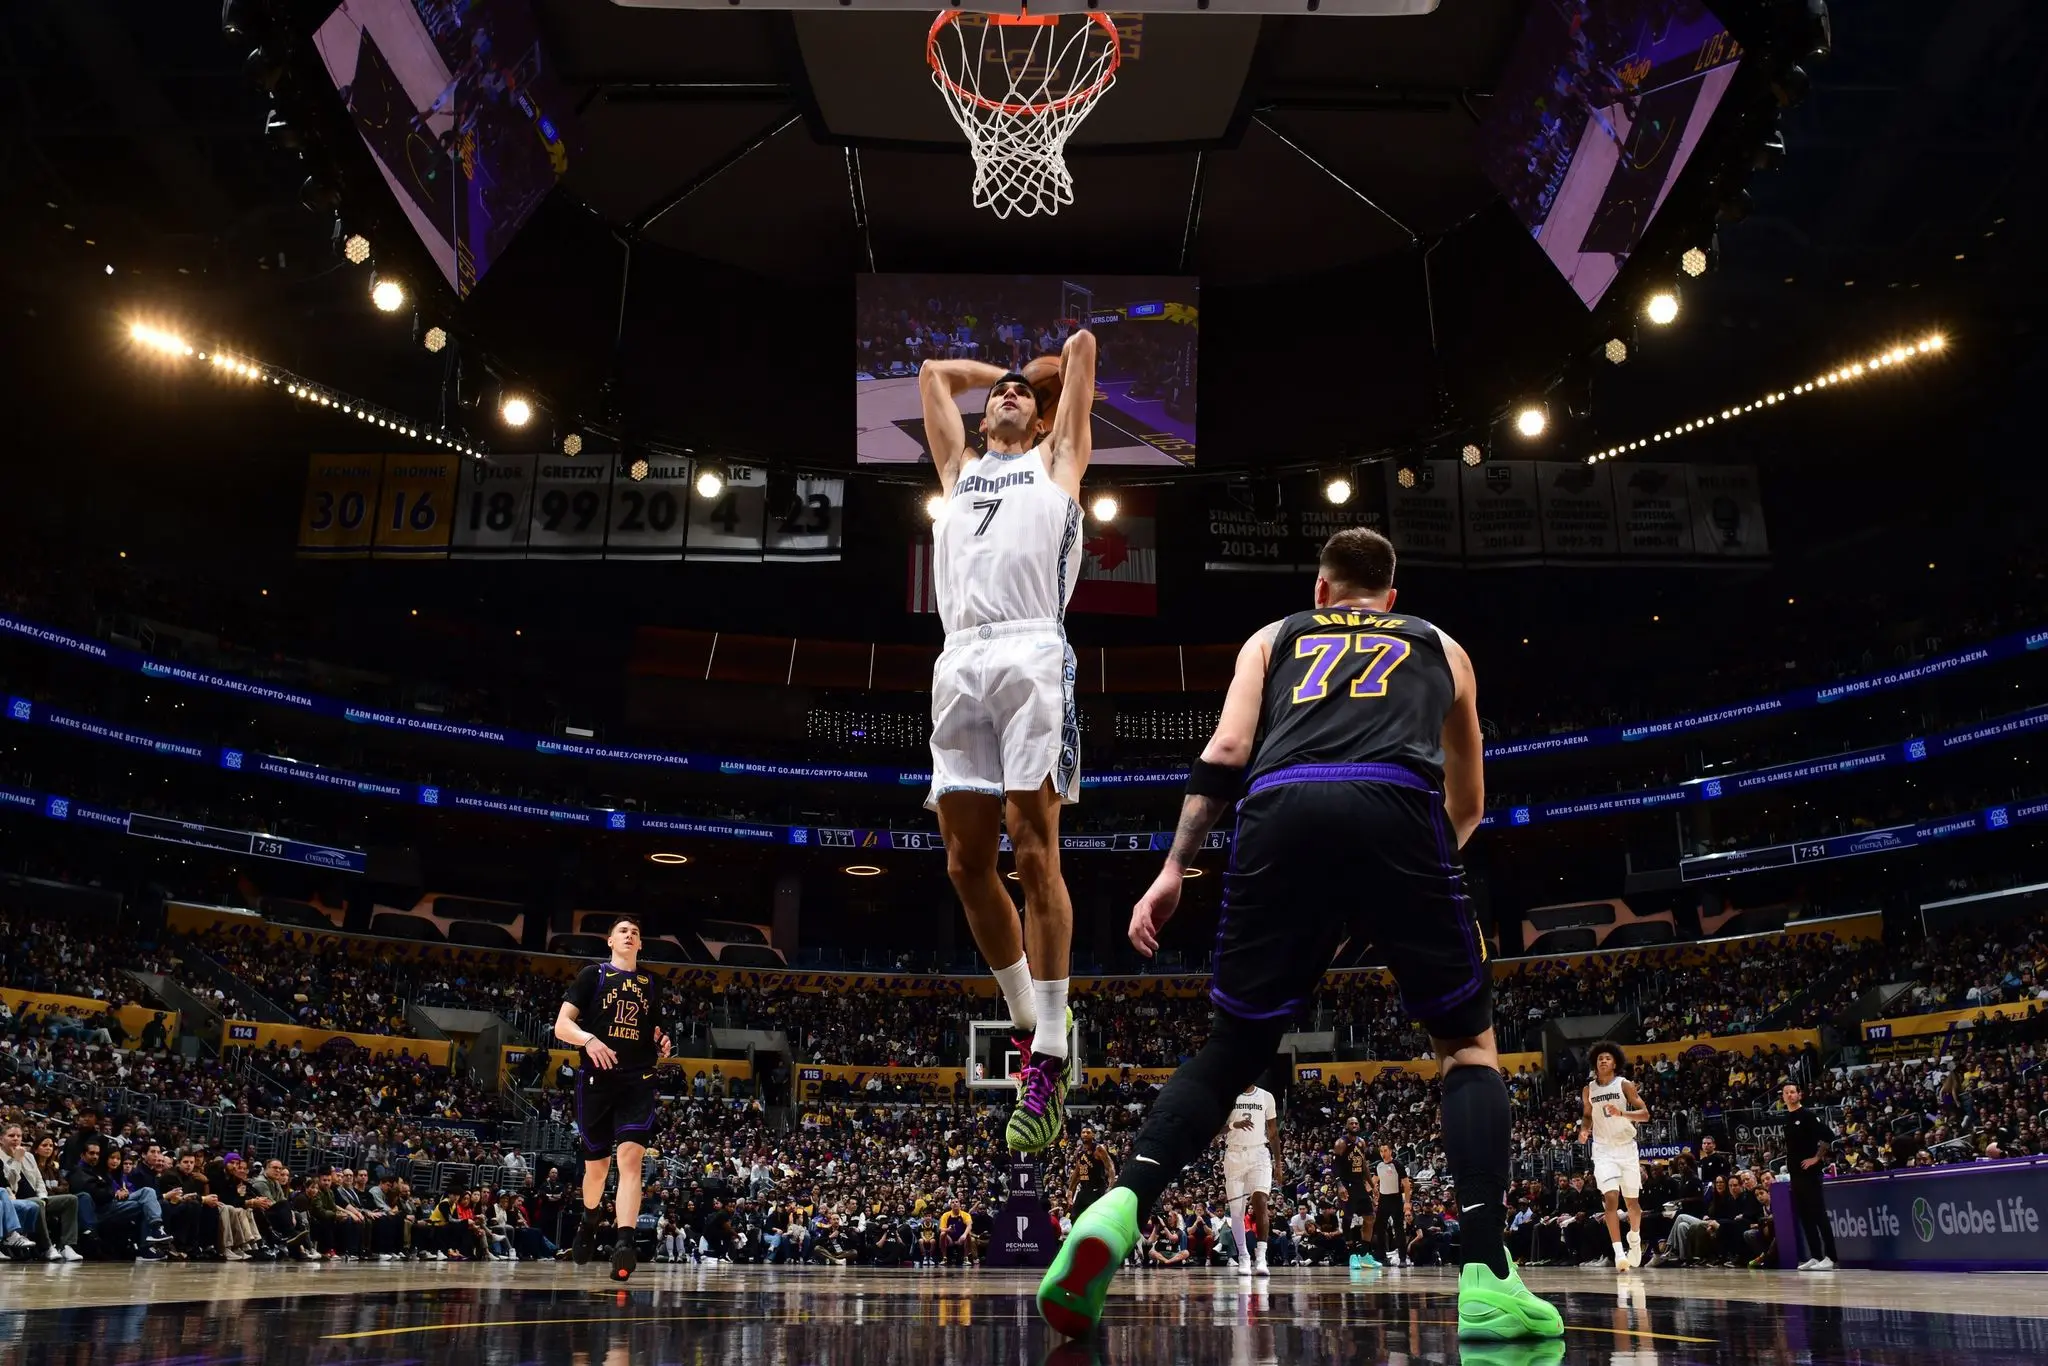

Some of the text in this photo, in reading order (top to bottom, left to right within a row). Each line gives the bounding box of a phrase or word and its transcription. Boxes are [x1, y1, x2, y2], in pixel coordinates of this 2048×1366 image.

[542, 465, 604, 478] GRETZKY
[310, 491, 367, 532] 30
[392, 491, 437, 532] 16
[469, 490, 515, 531] 18
[542, 490, 600, 531] 99
[617, 490, 678, 532] 20
[710, 492, 739, 532] 4
[778, 493, 831, 533] 23
[973, 498, 1003, 536] 7
[1301, 511, 1352, 523] STANLEY
[1356, 511, 1381, 522] CUP
[1208, 522, 1289, 537] CHAMPIONS
[1220, 541, 1280, 558] 2013-14
[143, 661, 171, 673] LEARN
[173, 668, 196, 680] MORE
[1292, 633, 1411, 704] 77
[1818, 687, 1844, 698] LEARN
[1846, 681, 1870, 692] MORE
[1873, 678, 1881, 686] AT
[346, 708, 370, 718] LEARN
[373, 713, 394, 723] MORE
[51, 715, 79, 728] LAKERS
[82, 723, 107, 735] GAMES
[109, 731, 123, 739] ARE
[125, 734, 153, 746] BETTER
[1623, 727, 1647, 736] LEARN
[1650, 723, 1672, 732] MORE
[1944, 714, 2048, 746] LAKERS GAMES ARE BETTER
[538, 741, 561, 750] LEARN
[563, 745, 583, 753] MORE
[260, 763, 287, 773] LAKERS
[290, 769, 313, 779] GAMES
[316, 774, 329, 782] ARE
[331, 777, 356, 787] BETTER
[1082, 774, 1100, 783] EARN
[1739, 777, 1766, 787] LAKERS
[1768, 772, 1792, 781] GAMES
[1795, 768, 1808, 776] ARE
[1811, 763, 1837, 773] BETTER
[456, 797, 482, 806] LAKERS
[484, 801, 507, 809] GAMES
[524, 807, 548, 815] BETTER
[1547, 807, 1572, 815] LAKERS
[1574, 804, 1597, 812] GAMES
[1615, 798, 1640, 806] BETTER
[78, 809, 121, 824] EXPERIENCE
[826, 836, 832, 845] 7
[842, 836, 847, 845] 1
[1916, 827, 1932, 838] ORE
[258, 840, 284, 855] 7:51
[902, 834, 921, 848] 16
[1064, 838, 1107, 848] Grizzlies
[1128, 836, 1138, 850] 5
[1212, 838, 1219, 848] 6
[1800, 844, 1826, 859] 7:51
[602, 988, 618, 1010] LOS
[614, 999, 640, 1027] 12
[233, 1027, 254, 1039] 114
[607, 1025, 641, 1041] LAKERS
[1869, 1026, 1887, 1039] 117
[803, 1070, 820, 1079] 115
[1640, 1145, 1681, 1157] AMPIONS
[1868, 1204, 1900, 1237] Life
[1937, 1195, 2040, 1235] Globe Life
